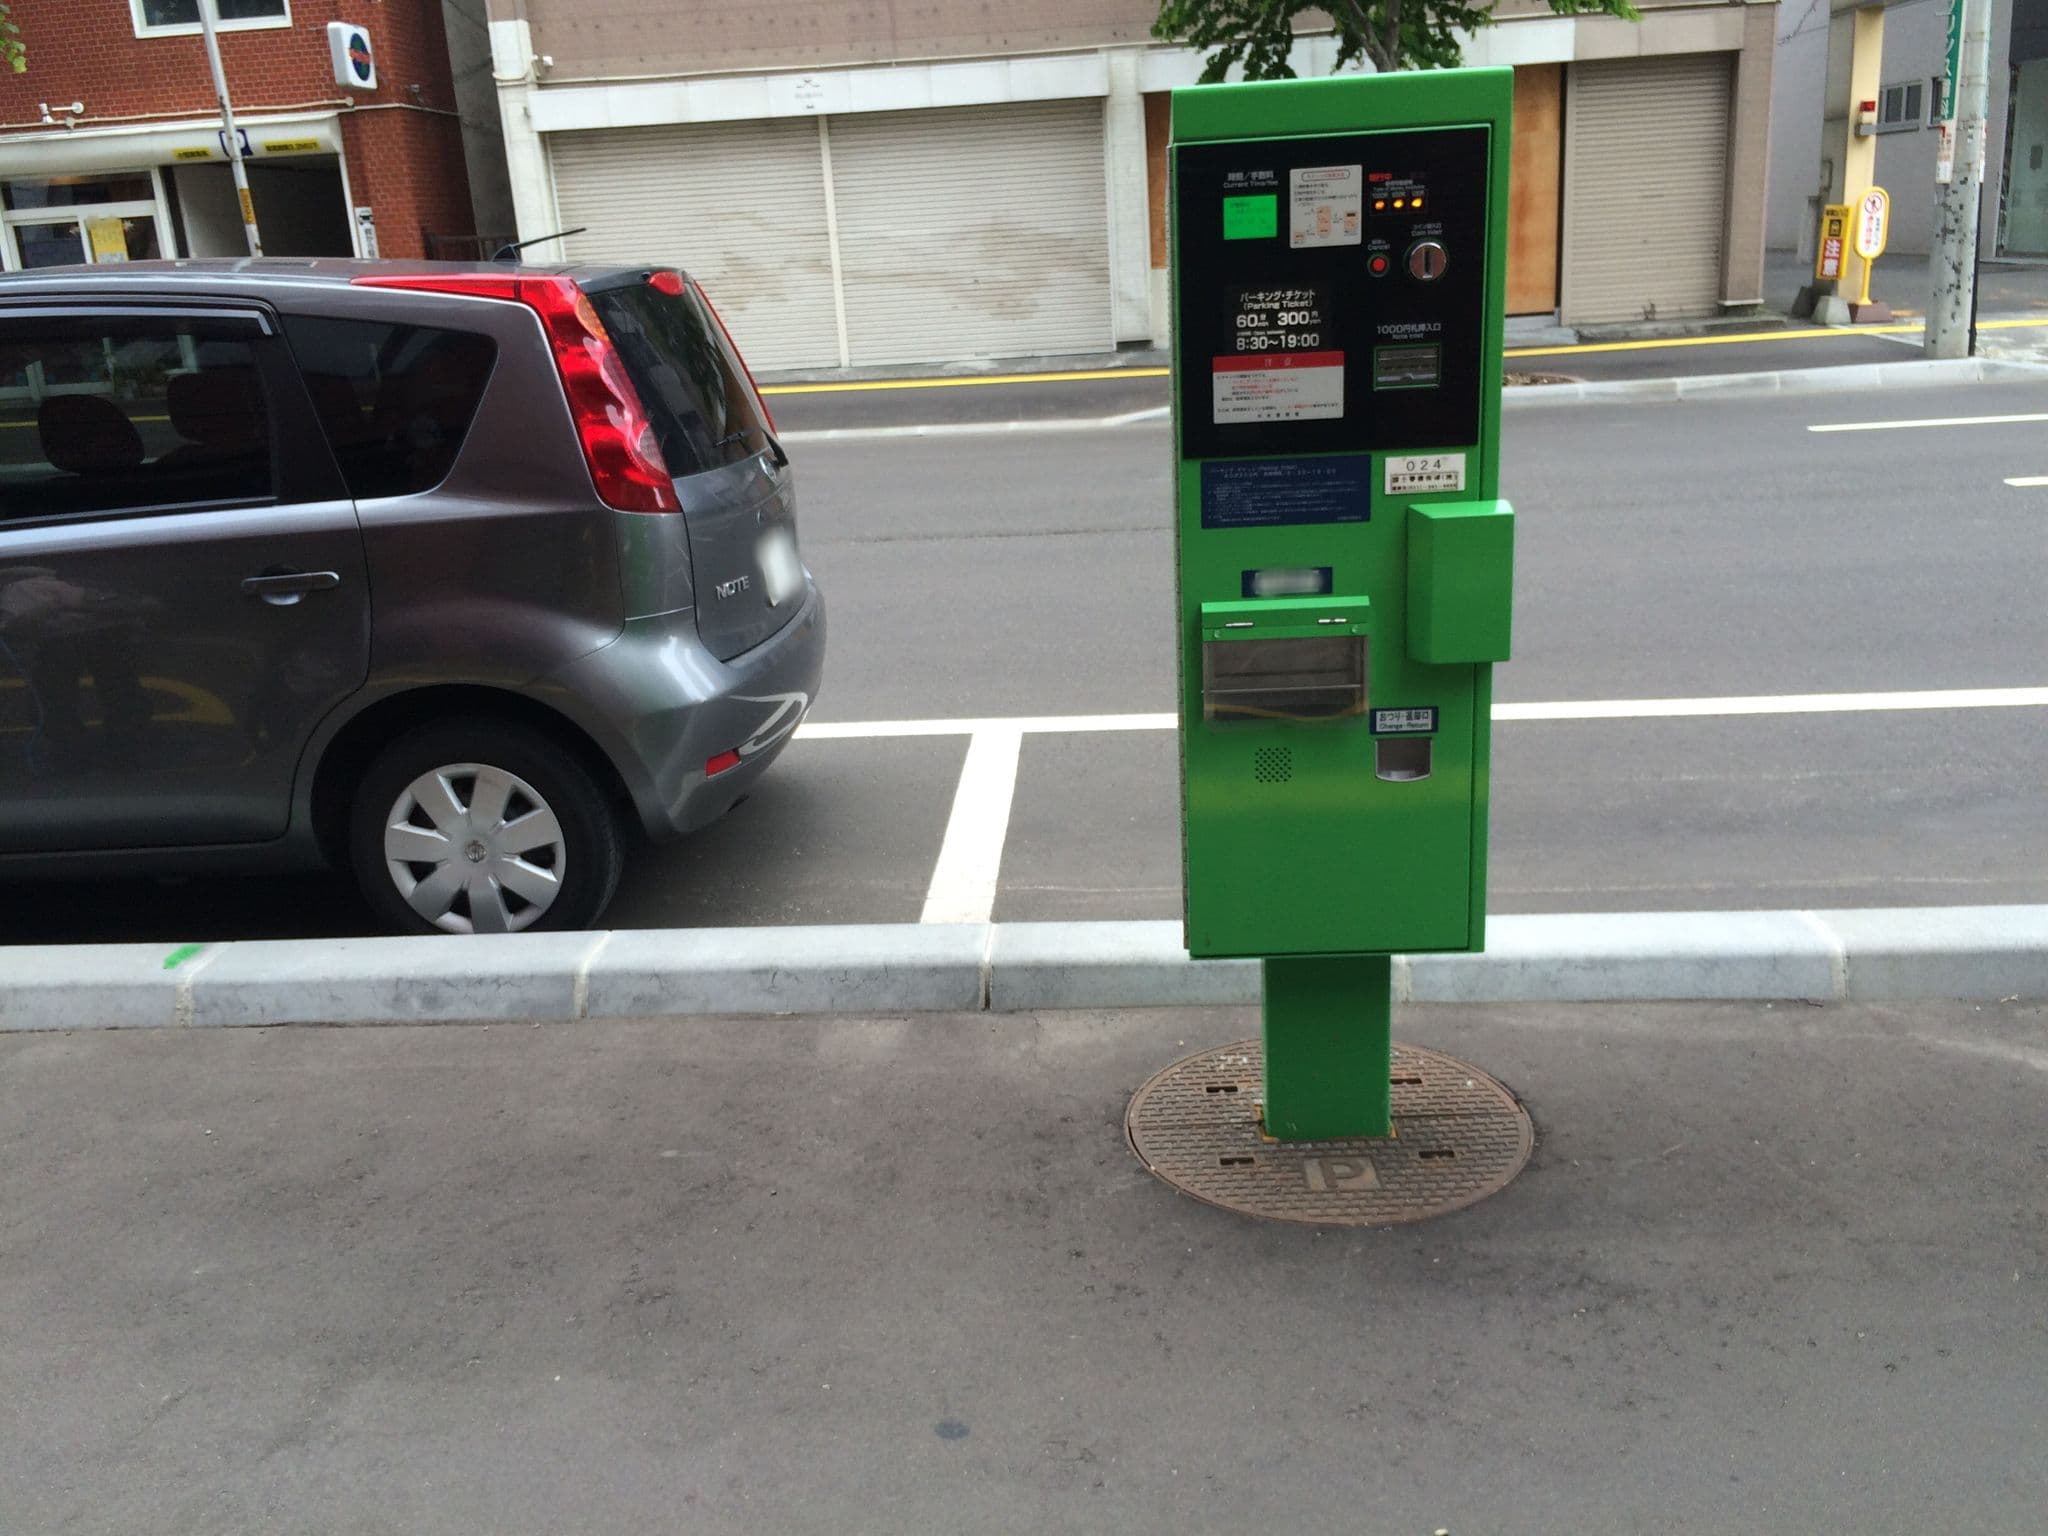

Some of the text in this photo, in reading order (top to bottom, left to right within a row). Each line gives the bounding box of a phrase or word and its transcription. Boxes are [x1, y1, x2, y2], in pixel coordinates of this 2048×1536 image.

[1240, 289, 1316, 302] パーキング・チケット
[1236, 314, 1259, 328] 60
[1277, 311, 1310, 326] 300
[715, 576, 749, 600] NOTE
[1318, 1157, 1366, 1188] P
